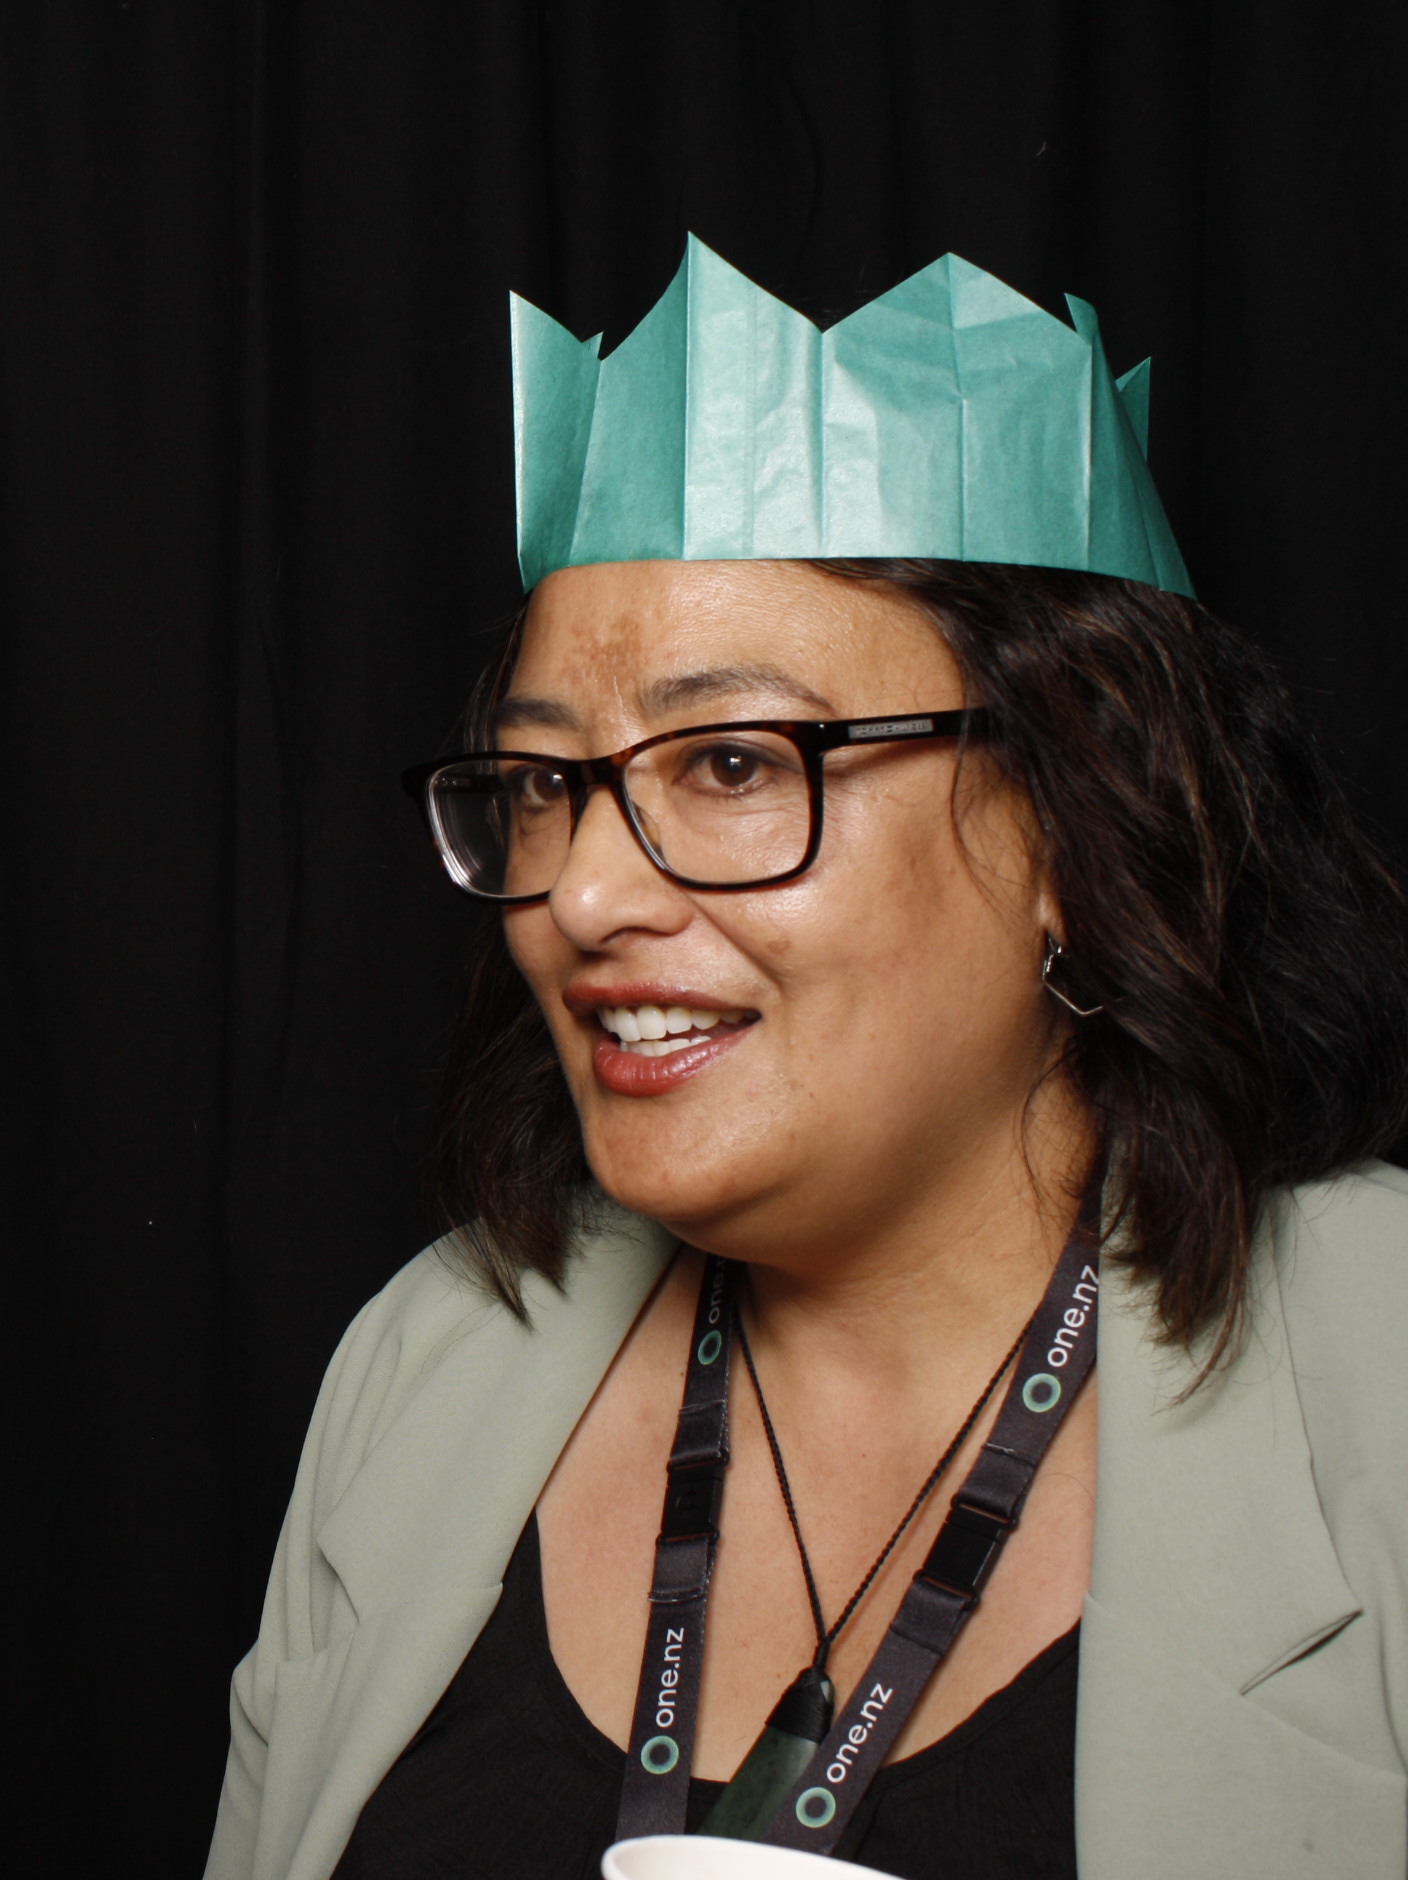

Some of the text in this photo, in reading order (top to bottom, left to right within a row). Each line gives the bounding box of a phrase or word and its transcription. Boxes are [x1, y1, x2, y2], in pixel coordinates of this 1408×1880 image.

[1047, 1264, 1100, 1368] one.nz
[655, 1626, 685, 1729] one.nz
[826, 1682, 893, 1784] one.nz
